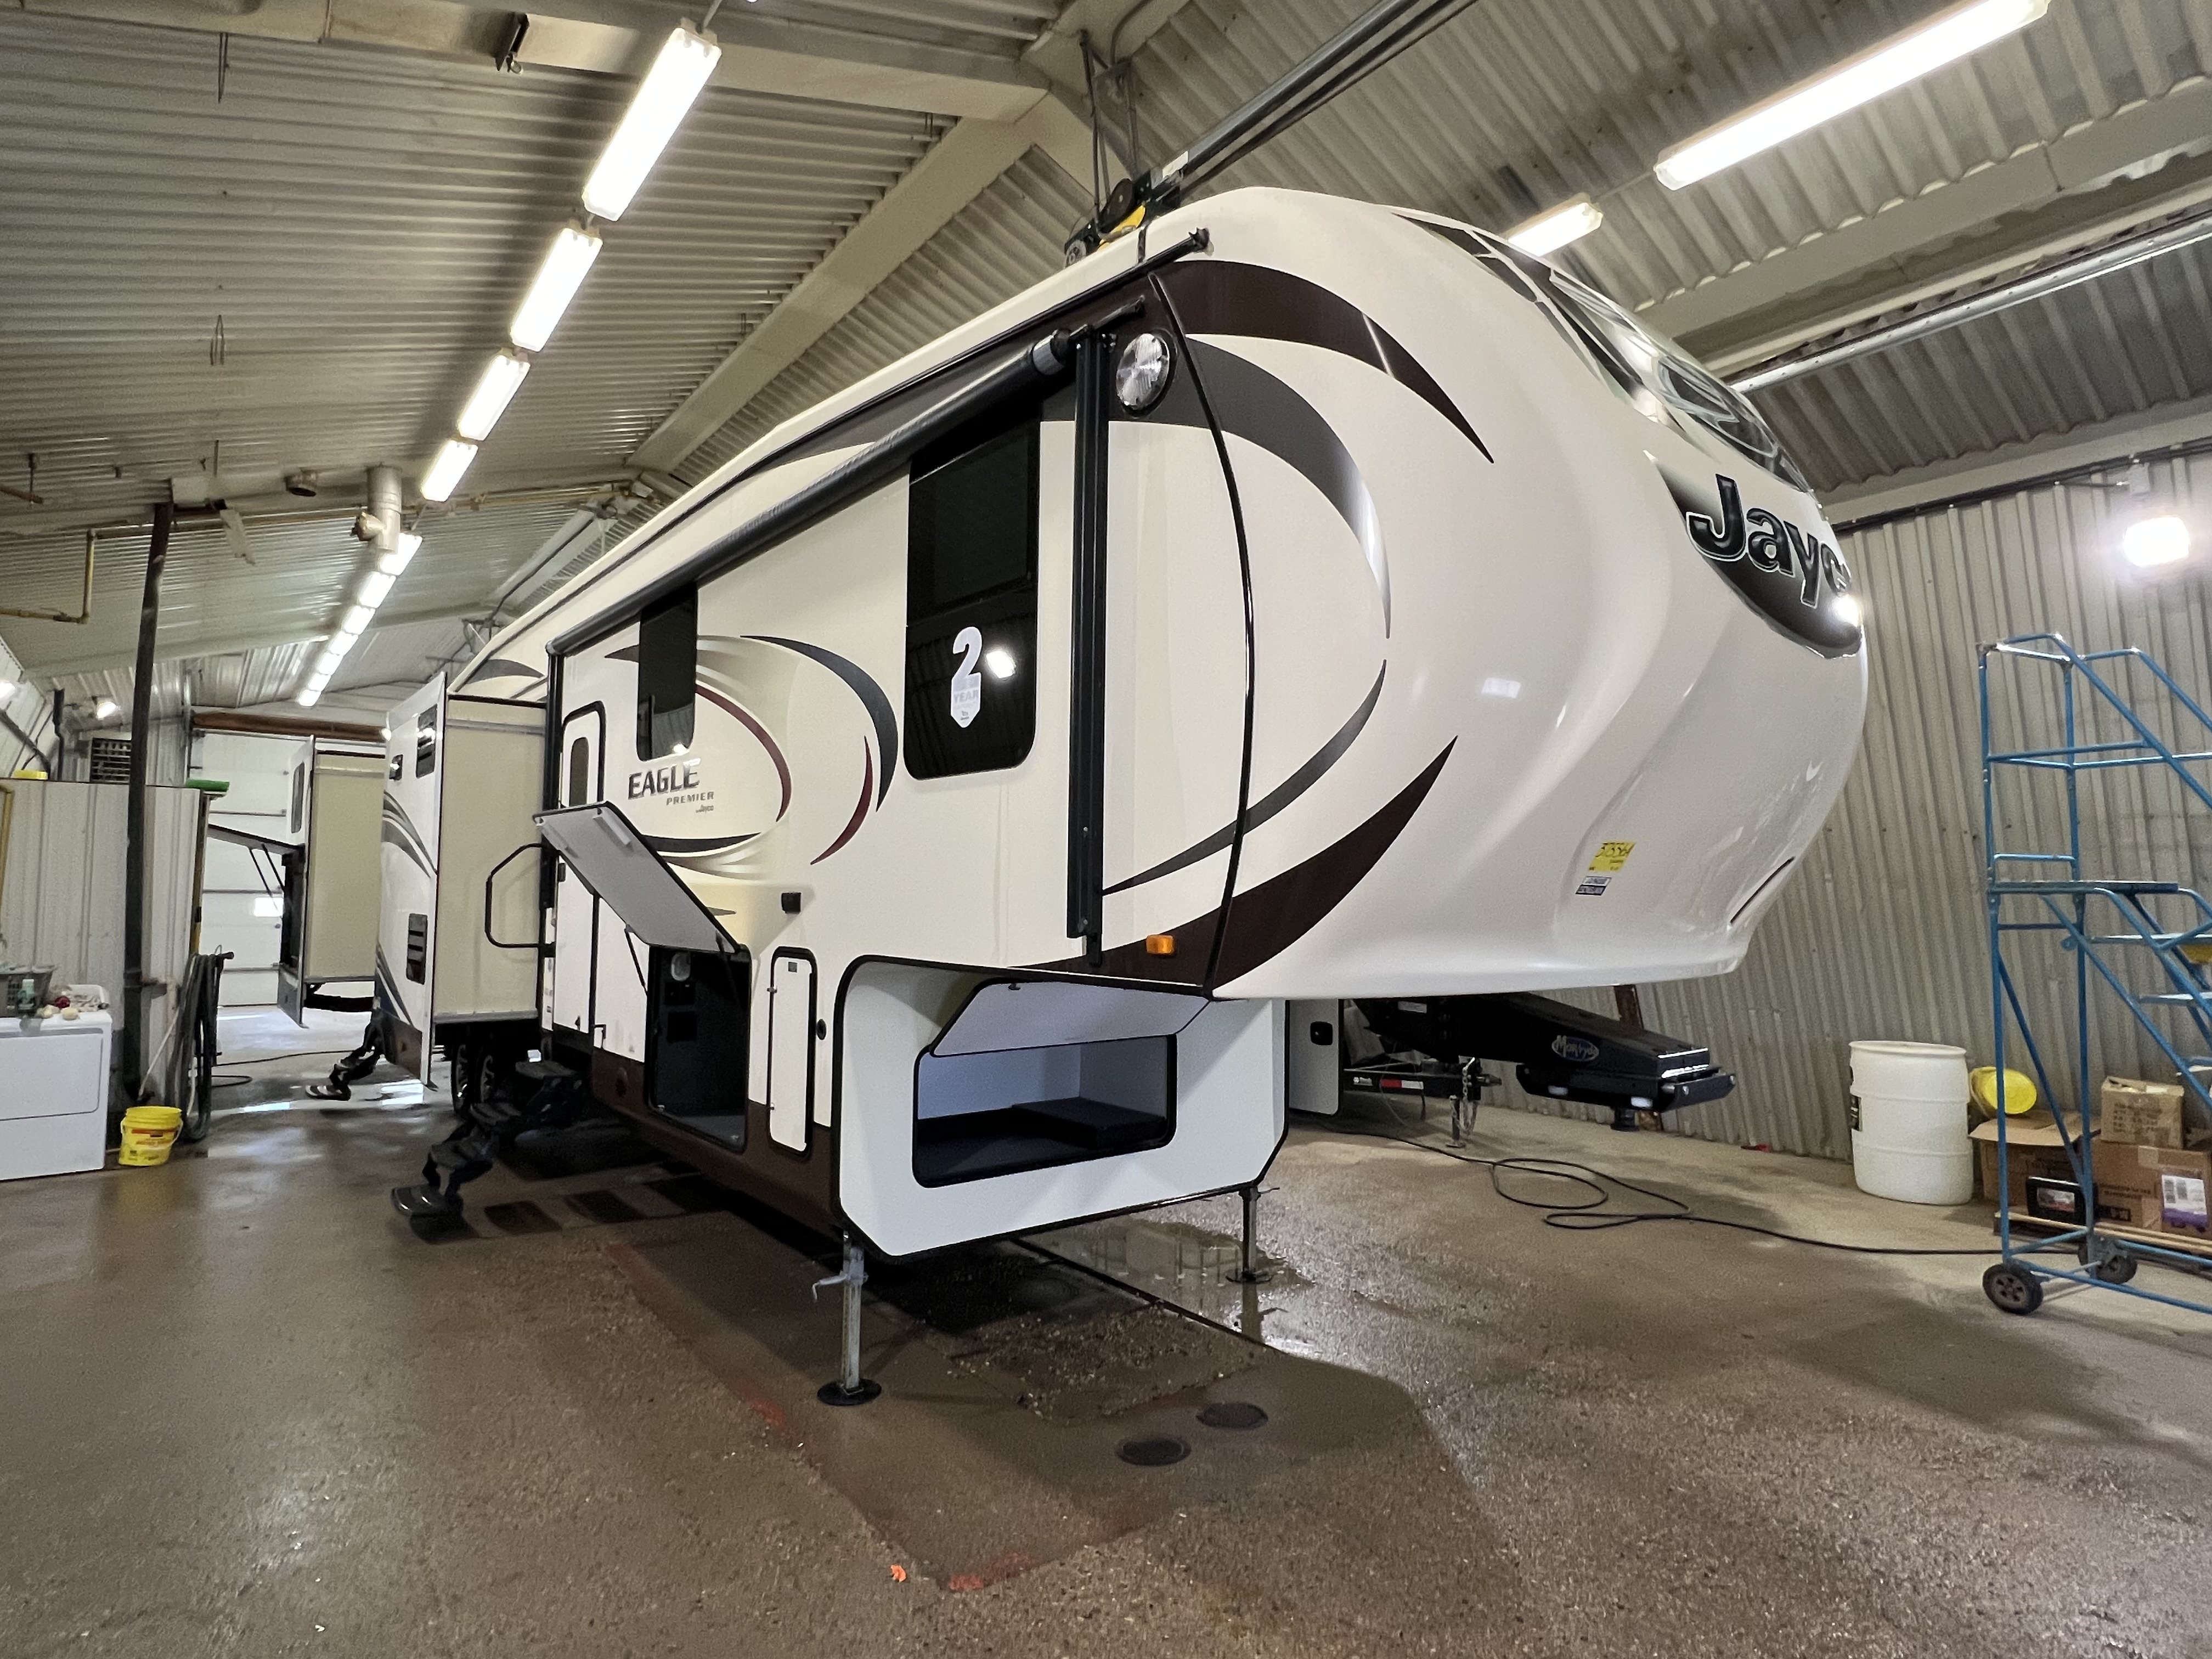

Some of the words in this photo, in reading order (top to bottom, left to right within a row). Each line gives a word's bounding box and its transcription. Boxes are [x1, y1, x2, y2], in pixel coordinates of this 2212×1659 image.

[951, 626, 982, 692] 2
[953, 689, 979, 703] YEAR
[628, 758, 701, 800] EAGLE
[666, 791, 714, 806] PREMIER
